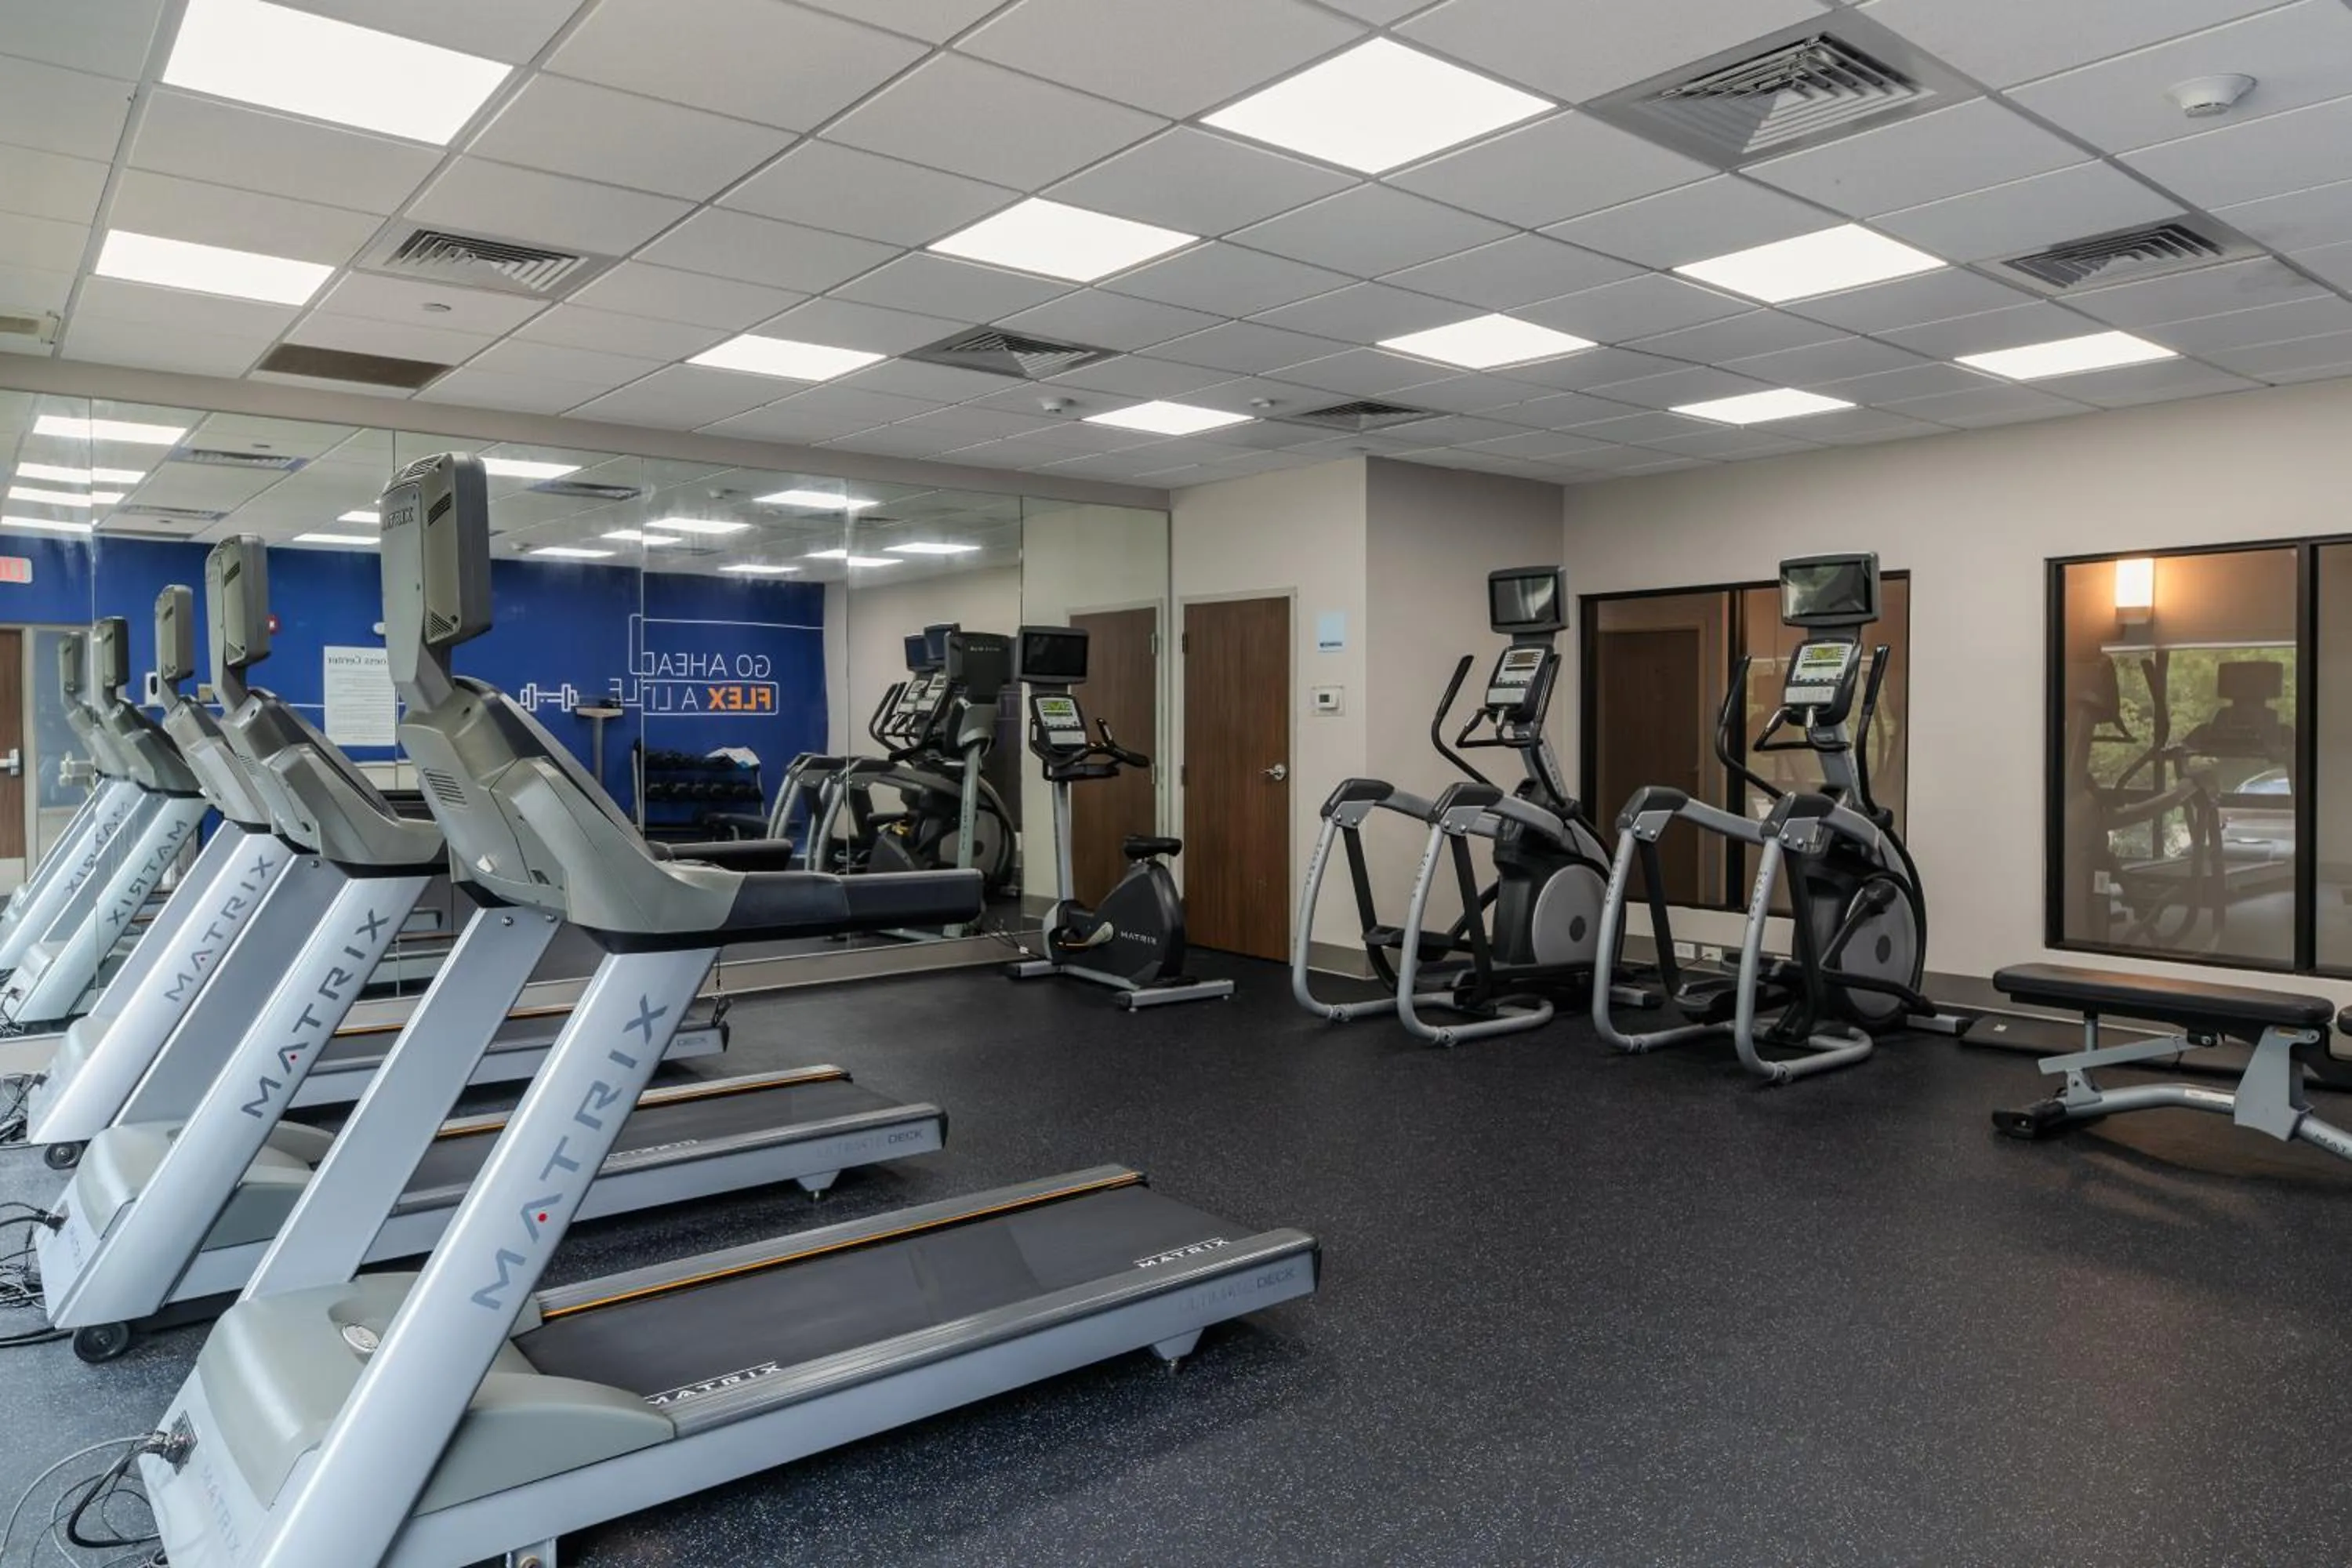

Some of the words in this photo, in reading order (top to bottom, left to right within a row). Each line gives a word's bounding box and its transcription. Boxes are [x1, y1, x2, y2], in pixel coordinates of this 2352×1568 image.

[163, 855, 275, 1002] MATRIX
[1120, 931, 1157, 946] MATRIX
[241, 907, 390, 1119] MATRIX
[471, 992, 669, 1311] MATRIX
[887, 1128, 924, 1144] DECK
[1256, 1266, 1295, 1289] DECK
[645, 1364, 782, 1405] MATRIX
